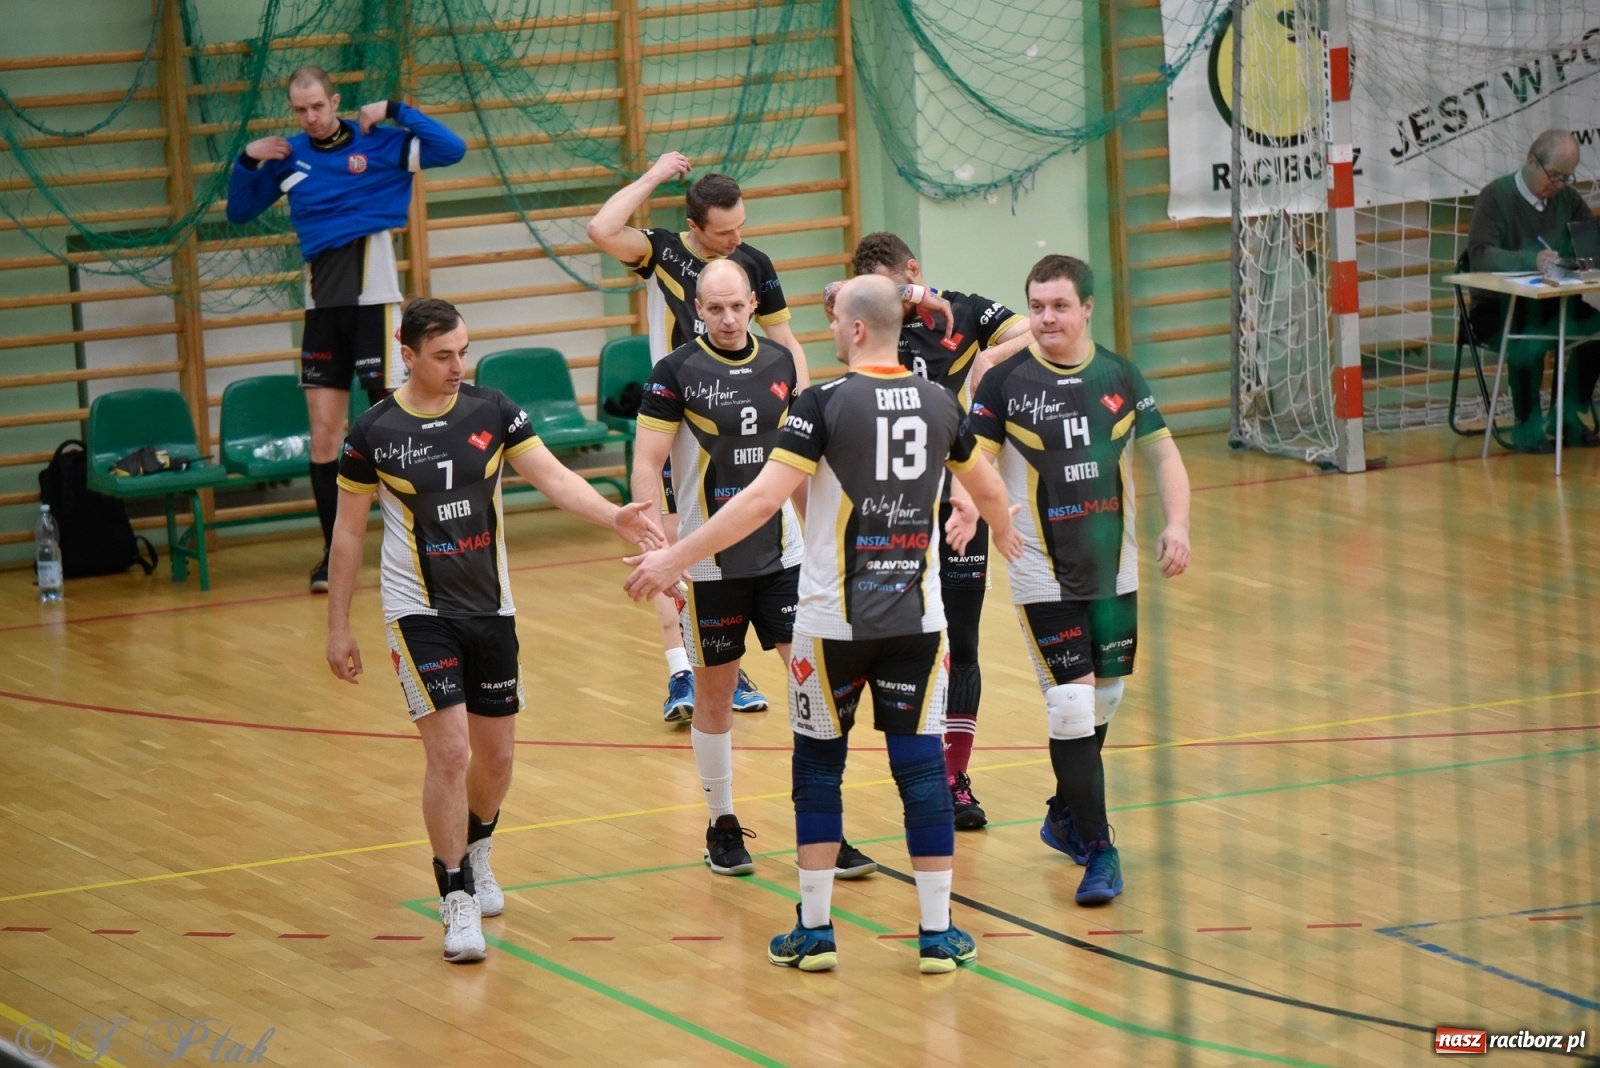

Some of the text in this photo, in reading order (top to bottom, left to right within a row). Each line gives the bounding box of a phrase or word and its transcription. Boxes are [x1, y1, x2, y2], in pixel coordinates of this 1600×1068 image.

[1389, 79, 1490, 158] JEST
[1501, 59, 1542, 104] W
[875, 387, 921, 411] ENTER
[740, 406, 758, 435] 2
[1063, 416, 1091, 449] 14
[734, 446, 764, 465] ENTER
[875, 415, 928, 481] 13
[437, 459, 453, 490] 7
[1064, 461, 1099, 483] ENTER
[437, 499, 471, 522] ENTER
[866, 560, 920, 570] GRAVTON
[948, 555, 985, 563] GRAVTON
[480, 678, 516, 690] GRAVTON
[795, 690, 811, 720] 13
